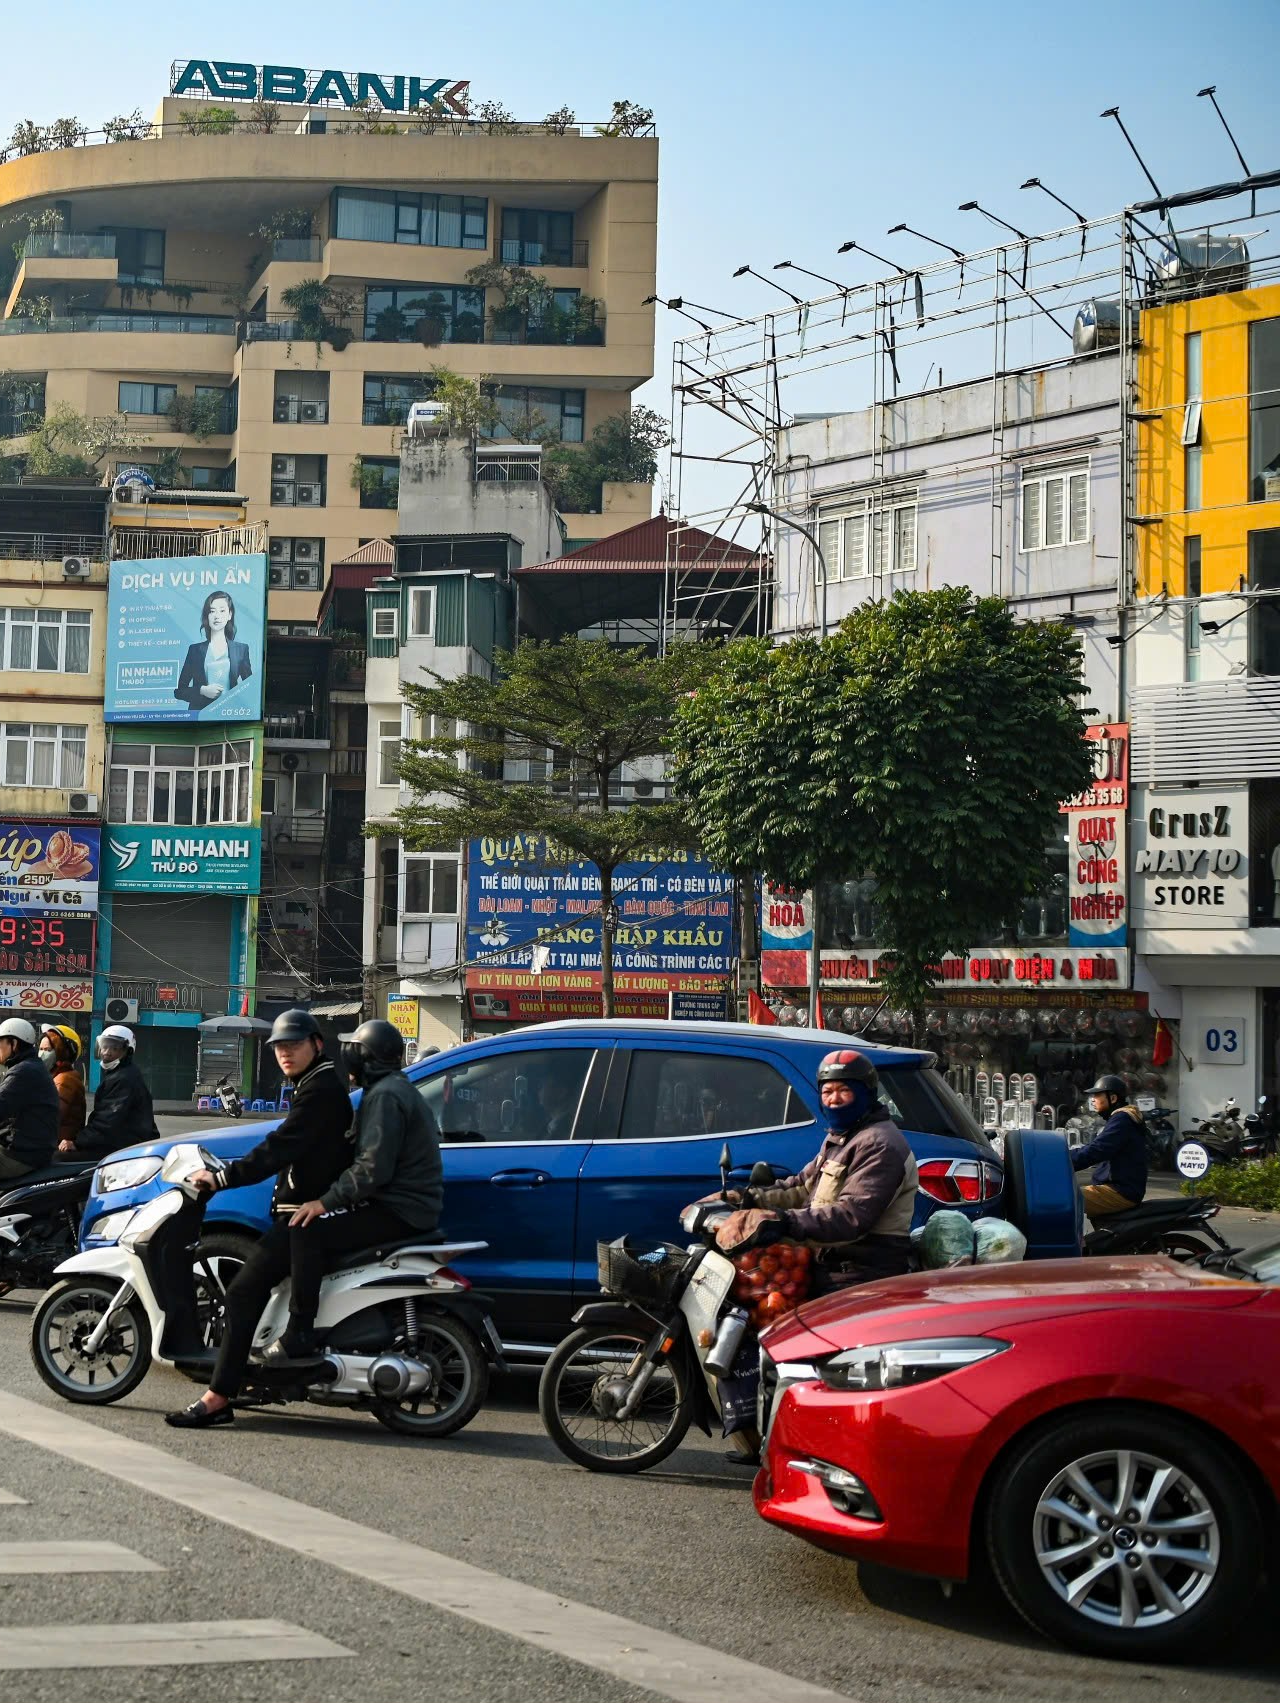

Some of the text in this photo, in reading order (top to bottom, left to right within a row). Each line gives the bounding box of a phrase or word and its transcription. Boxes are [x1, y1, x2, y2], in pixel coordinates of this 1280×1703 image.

[172, 60, 452, 114] ABBANK
[122, 561, 251, 593] DỊCH VỤ IN ẤN
[121, 666, 173, 678] IN NHANH
[246, 708, 251, 716] 2
[1097, 788, 1109, 806] 35
[1111, 786, 1123, 805] 68
[1149, 806, 1230, 837] GrusZ
[1078, 817, 1117, 848] QUẠT
[151, 839, 249, 858] IN NHANH
[481, 834, 539, 866] QUẠT
[151, 858, 176, 873] THỦ
[178, 861, 199, 873] ĐÔ
[1077, 854, 1119, 885] CÔNG
[1135, 849, 1240, 873] MAY 10
[24, 874, 51, 885] 250K
[480, 872, 722, 893] THẾ GIỚI QUẠT TRẦN ĐÈN RANG TRÍ CÓ ĐÈN VÀ
[0, 889, 31, 905] Ngư
[62, 890, 82, 905] Cá
[1154, 885, 1225, 906] STORE
[496, 898, 523, 913] LOAN
[532, 896, 557, 916] NHẬT
[708, 902, 729, 917] LAN
[1070, 890, 1126, 925] NGHIỆP
[0, 918, 65, 947] 9:35
[537, 921, 724, 949] HÀNG HẬP KHẨU
[24, 949, 50, 973] SÀI
[55, 948, 87, 974] GÒN
[559, 953, 578, 968] TẠI
[626, 952, 658, 968] CÔNG
[661, 952, 696, 969] TRÌNH
[699, 953, 723, 970] CÁC
[820, 954, 869, 980] HUYÊN
[970, 958, 1011, 984] QUẠT
[1014, 952, 1055, 985] ĐIỆN
[1060, 958, 1074, 980] 4
[1078, 953, 1118, 981] MÙA
[480, 974, 493, 985] UY
[496, 973, 512, 986] TÍN
[564, 975, 592, 988] VÀNG
[633, 976, 669, 992] LƯỢNG
[20, 988, 85, 1010] 20%
[391, 1002, 416, 1014] NHẬN
[393, 1013, 412, 1024] SỬA
[1206, 1029, 1238, 1053] 03
